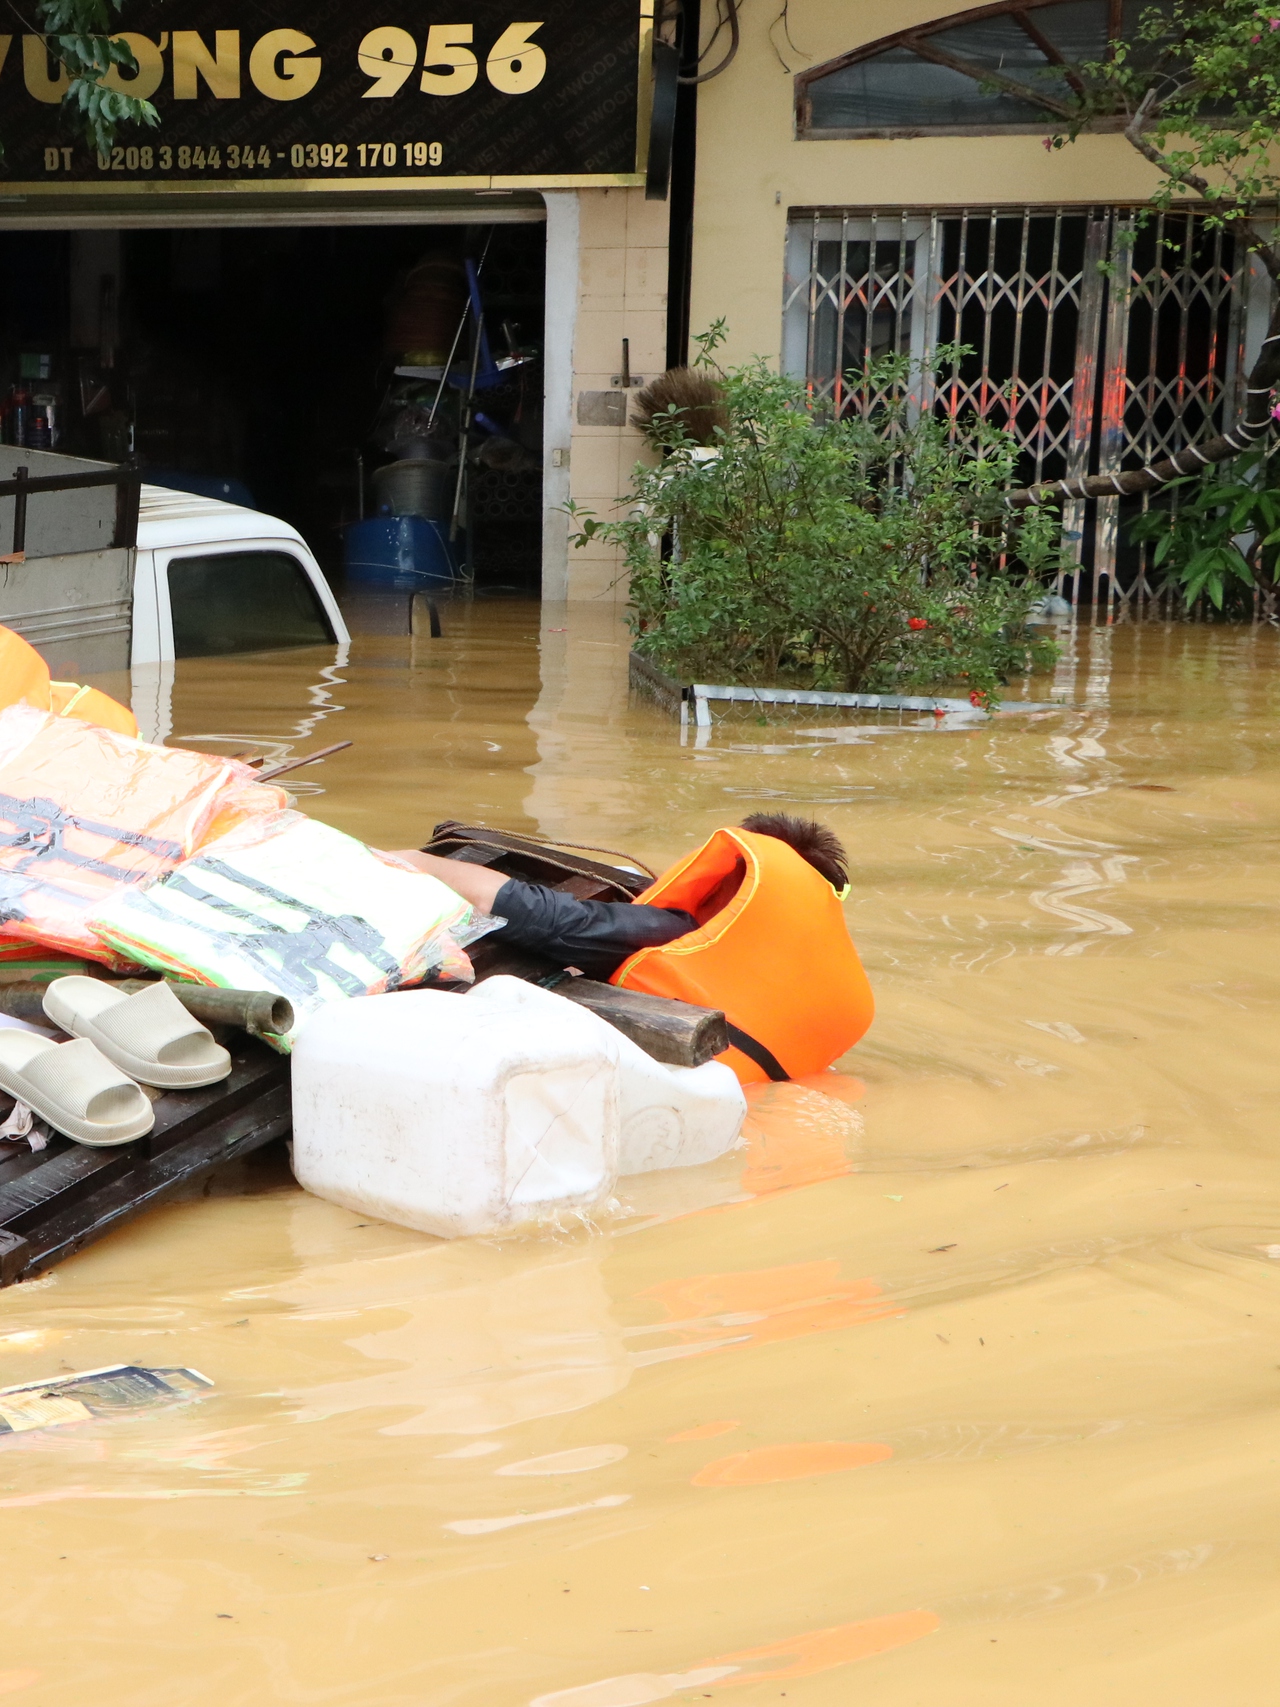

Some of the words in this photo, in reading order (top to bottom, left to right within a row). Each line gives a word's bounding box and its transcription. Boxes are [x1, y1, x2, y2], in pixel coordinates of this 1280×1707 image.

[357, 21, 548, 99] 956
[43, 147, 74, 171] ĐT
[97, 146, 154, 171] 0208
[159, 146, 173, 170] 3
[177, 146, 222, 170] 844
[226, 144, 272, 170] 344
[290, 143, 349, 168] 0392
[356, 142, 397, 168] 170
[402, 142, 443, 167] 199
